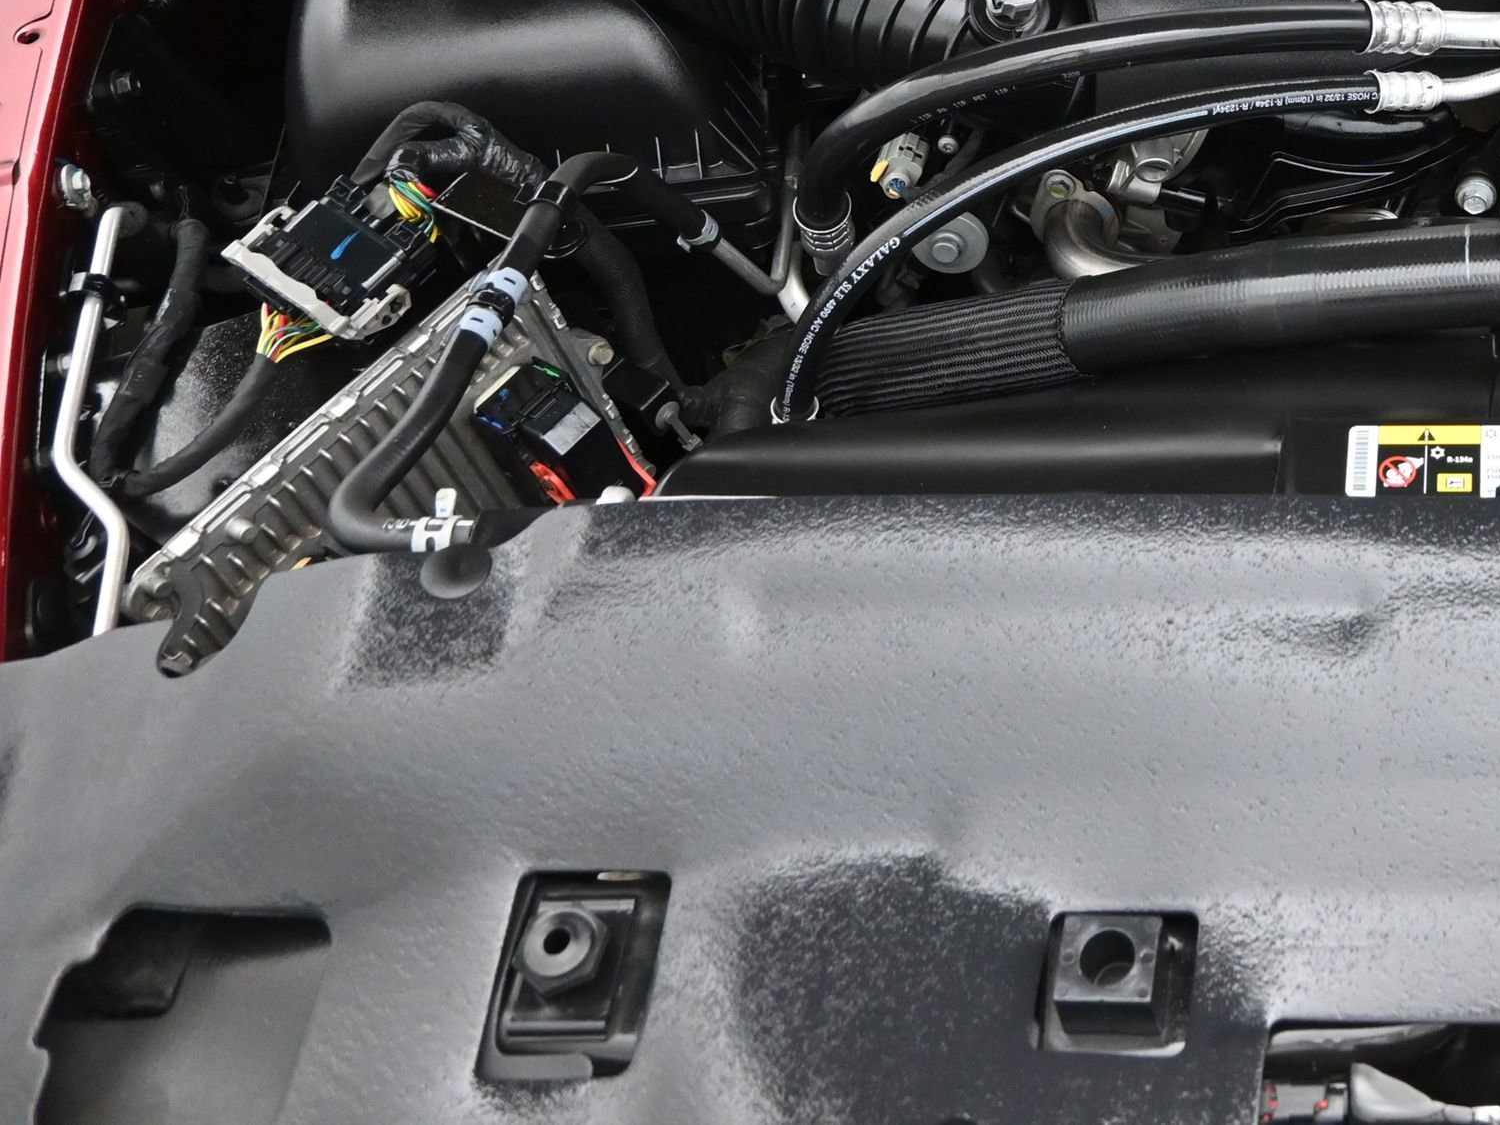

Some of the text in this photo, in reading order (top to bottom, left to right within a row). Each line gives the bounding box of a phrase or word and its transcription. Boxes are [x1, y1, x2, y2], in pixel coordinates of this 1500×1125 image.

[1347, 92, 1370, 100] HOSE
[851, 235, 902, 285] GALAXY
[833, 279, 853, 301] SLE
[810, 316, 824, 333] A/C
[799, 331, 817, 354] HOSE
